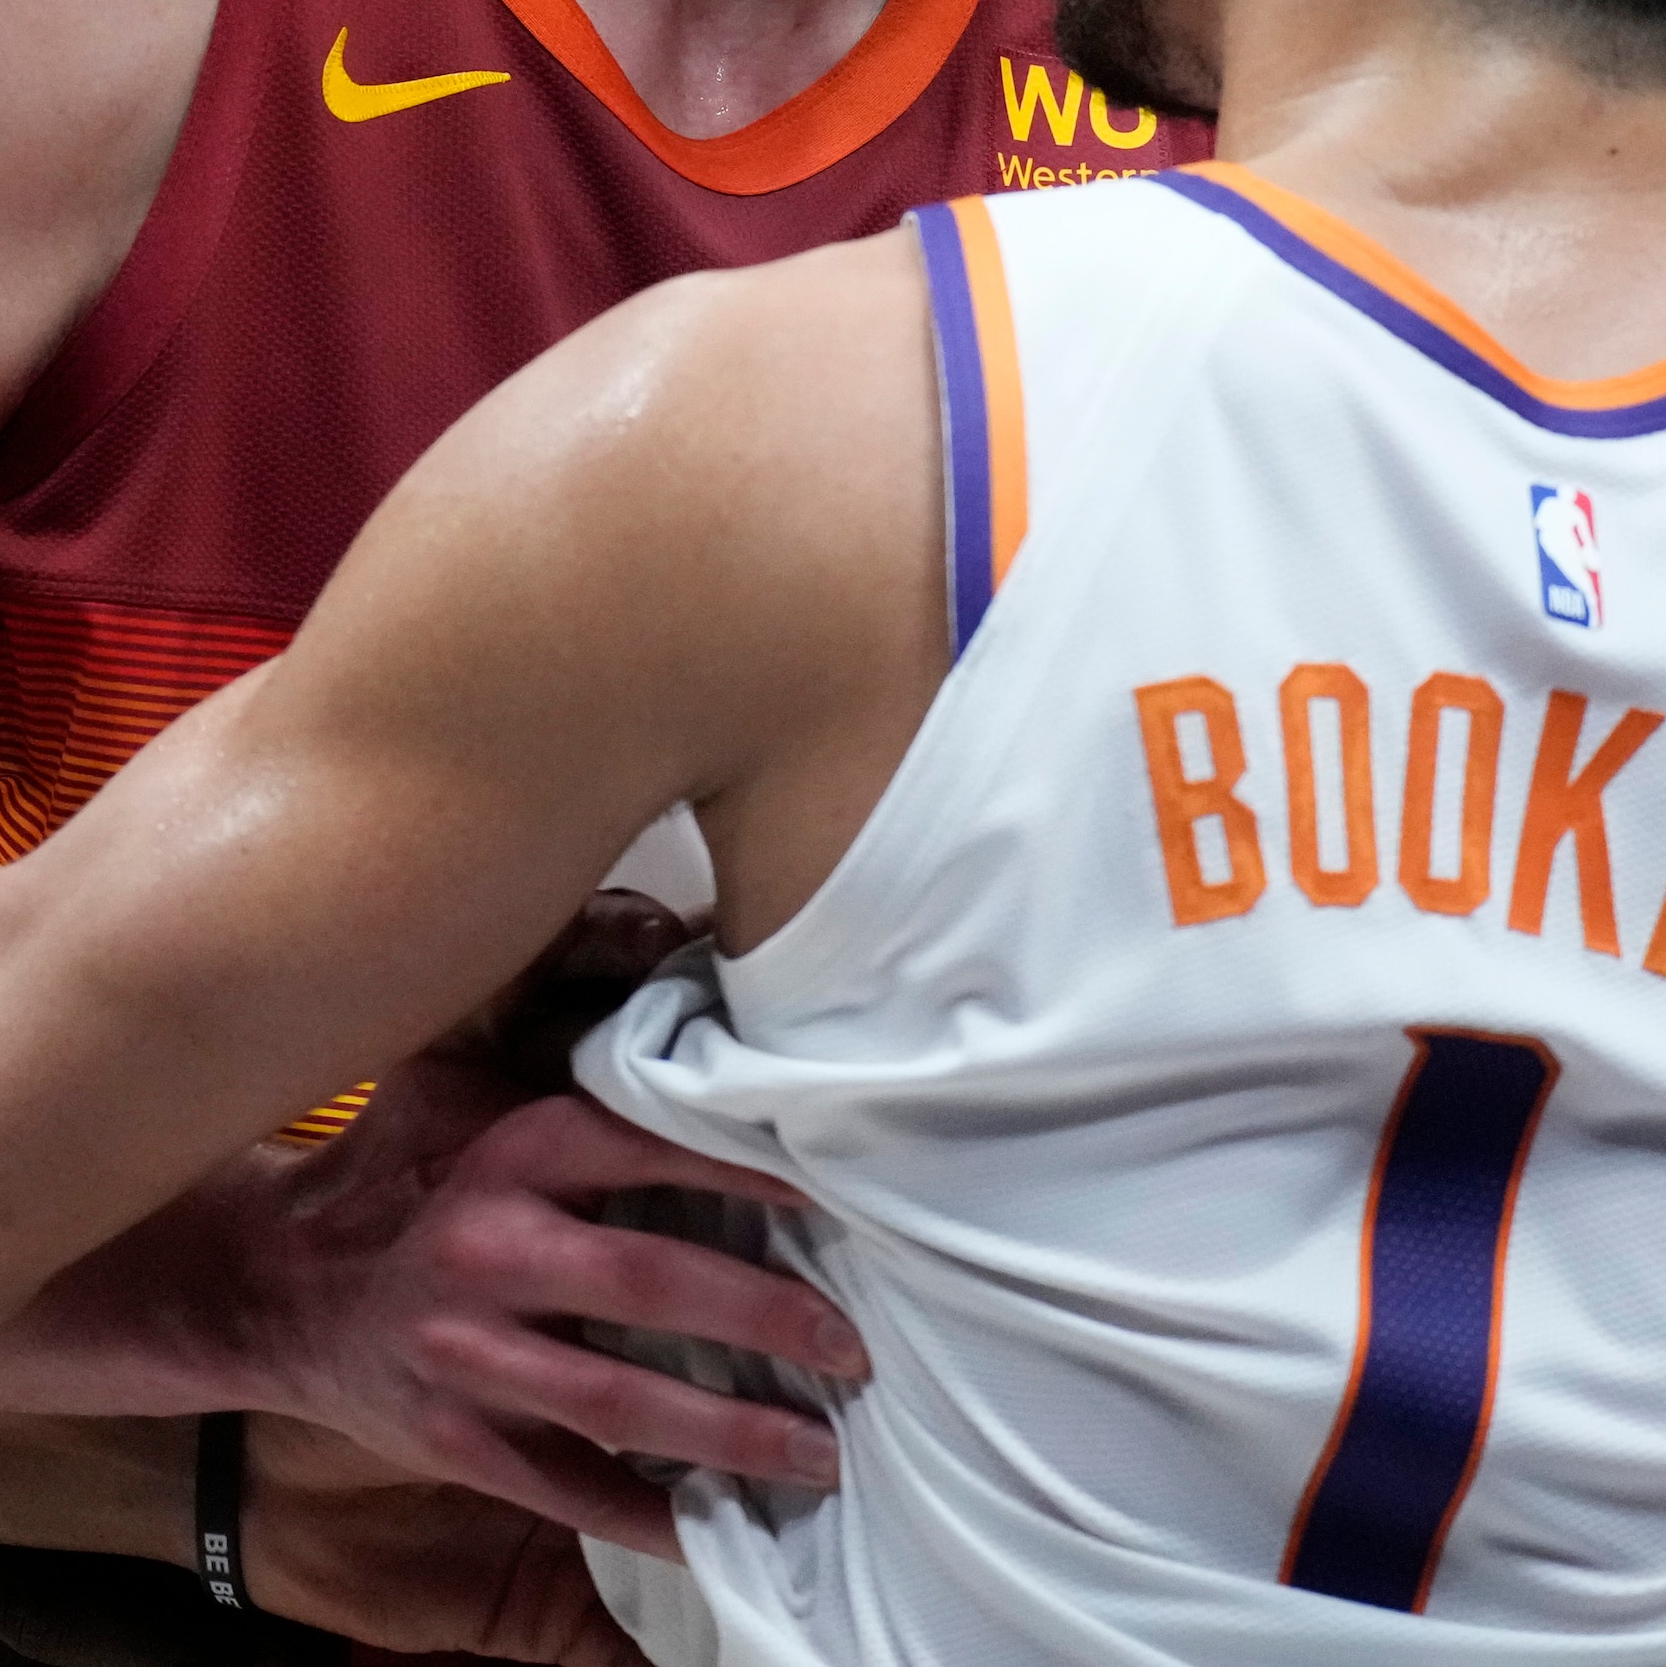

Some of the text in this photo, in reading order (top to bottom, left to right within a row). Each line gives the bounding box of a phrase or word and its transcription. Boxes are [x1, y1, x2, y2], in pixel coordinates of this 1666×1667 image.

[1000, 56, 1157, 150] WU
[1277, 1024, 1563, 1616] 1
[204, 1533, 230, 1574] BE
